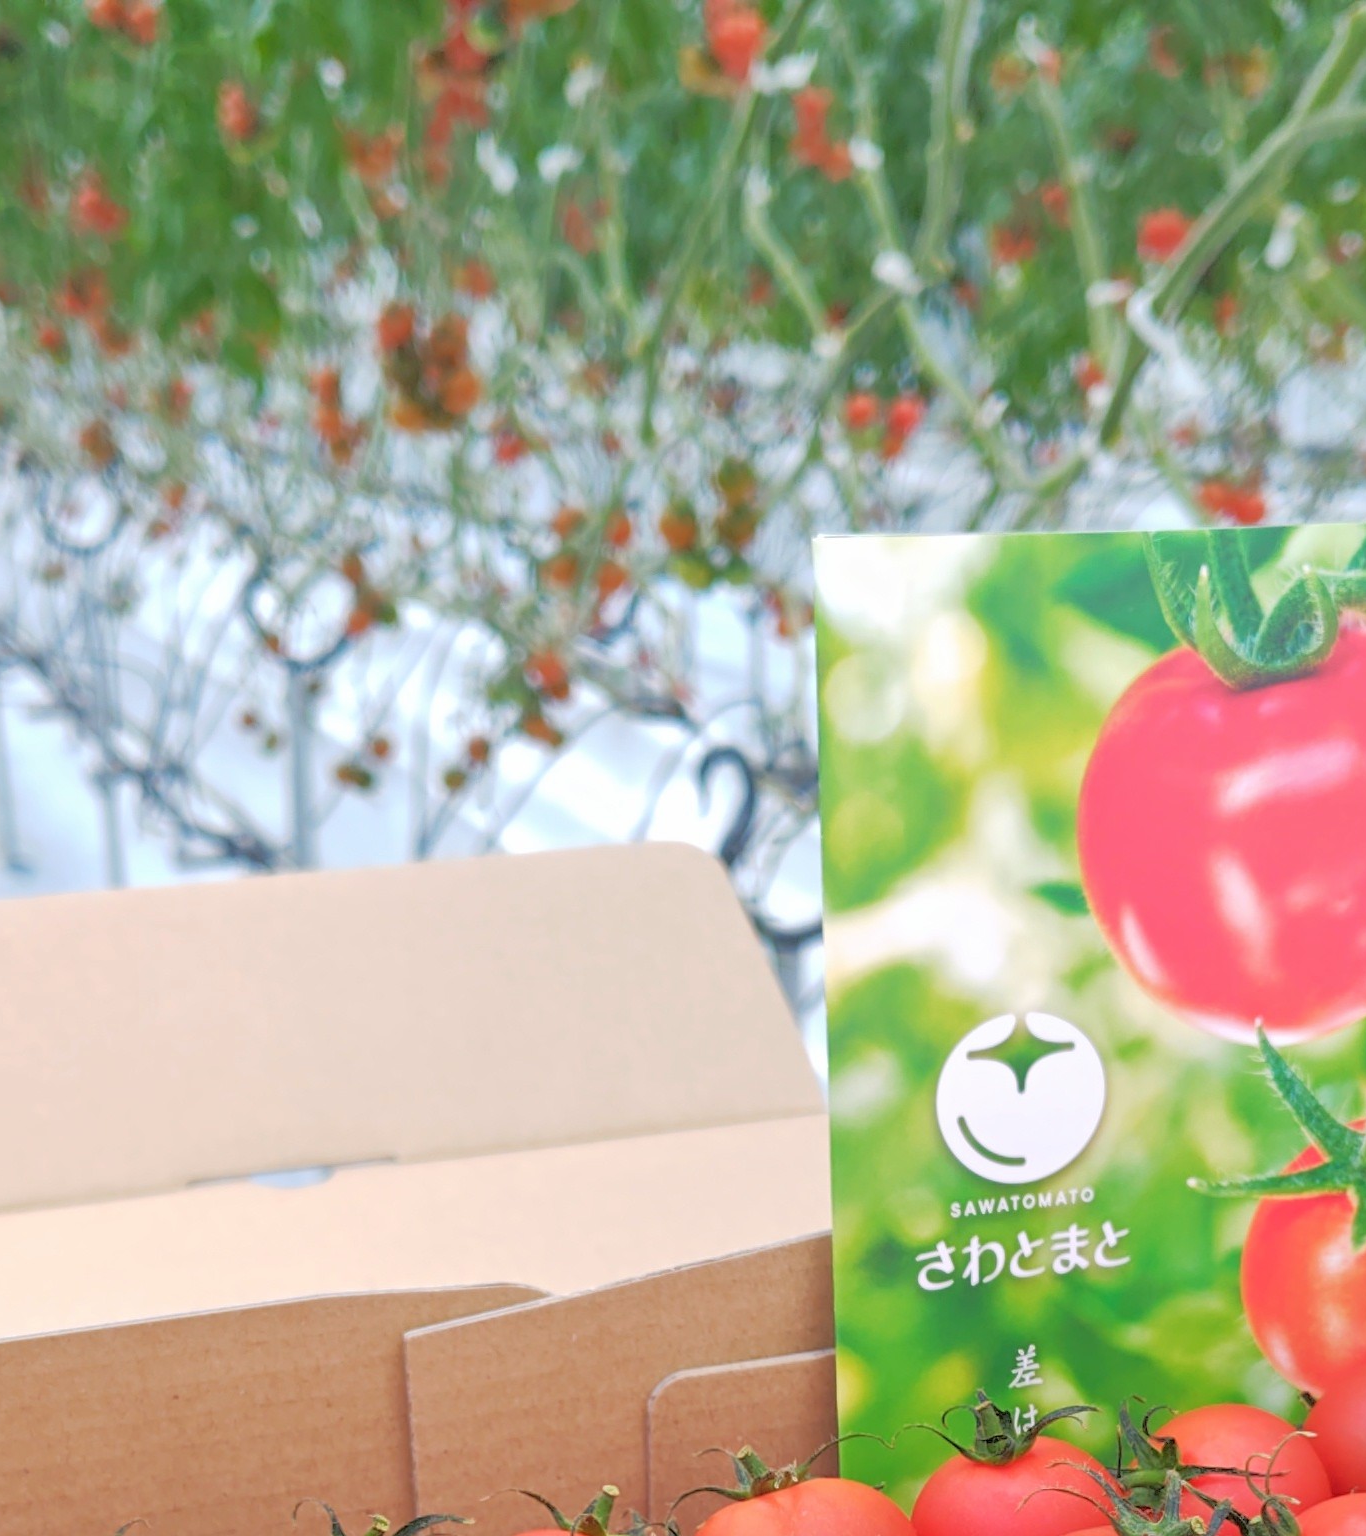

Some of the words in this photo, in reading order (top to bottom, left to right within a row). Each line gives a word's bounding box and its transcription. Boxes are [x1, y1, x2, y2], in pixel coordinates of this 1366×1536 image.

[949, 1187, 1096, 1219] SAWATOMATO
[914, 1220, 1131, 1292] さわとまと
